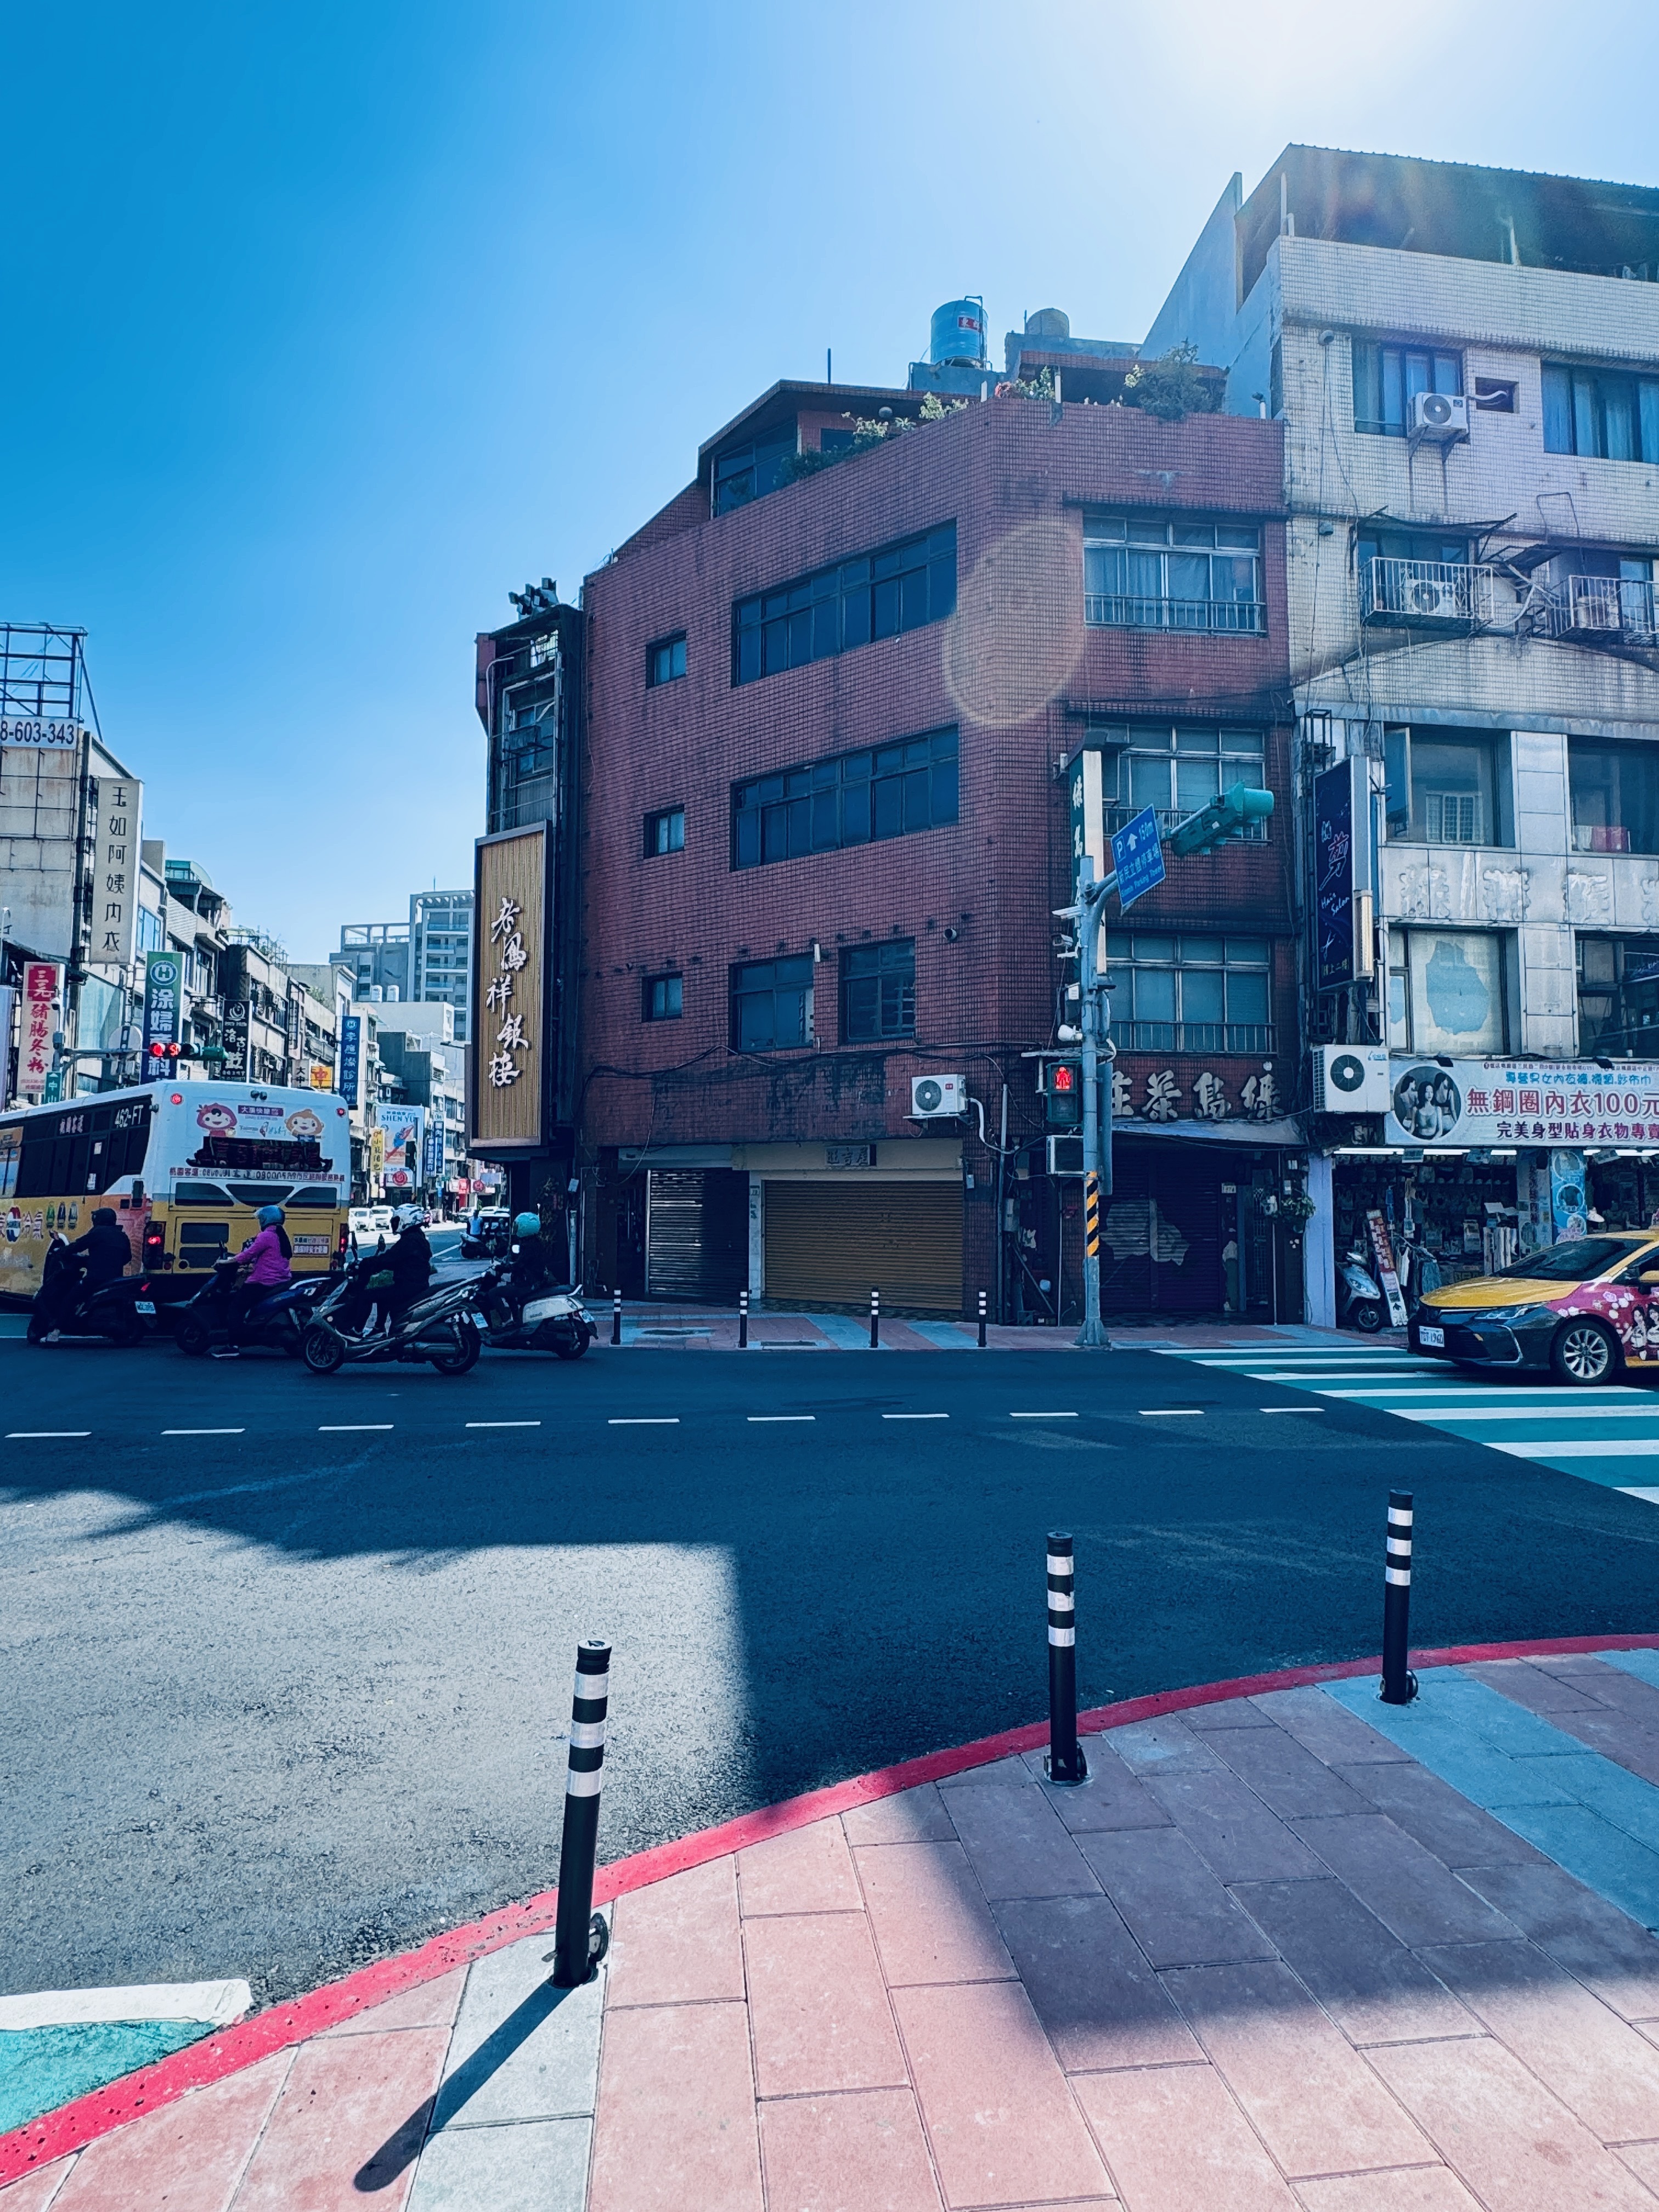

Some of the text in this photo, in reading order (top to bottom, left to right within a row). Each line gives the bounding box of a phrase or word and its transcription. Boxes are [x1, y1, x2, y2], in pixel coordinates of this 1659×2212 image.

[1, 720, 75, 745] 8-603-343
[1321, 893, 1336, 909] Hair
[1331, 896, 1350, 917] Salon
[486, 898, 528, 1087] 老鳳祥銀樓
[1467, 1088, 1659, 1116] 無鋼圈內衣100元
[115, 1105, 144, 1128] 462-FT
